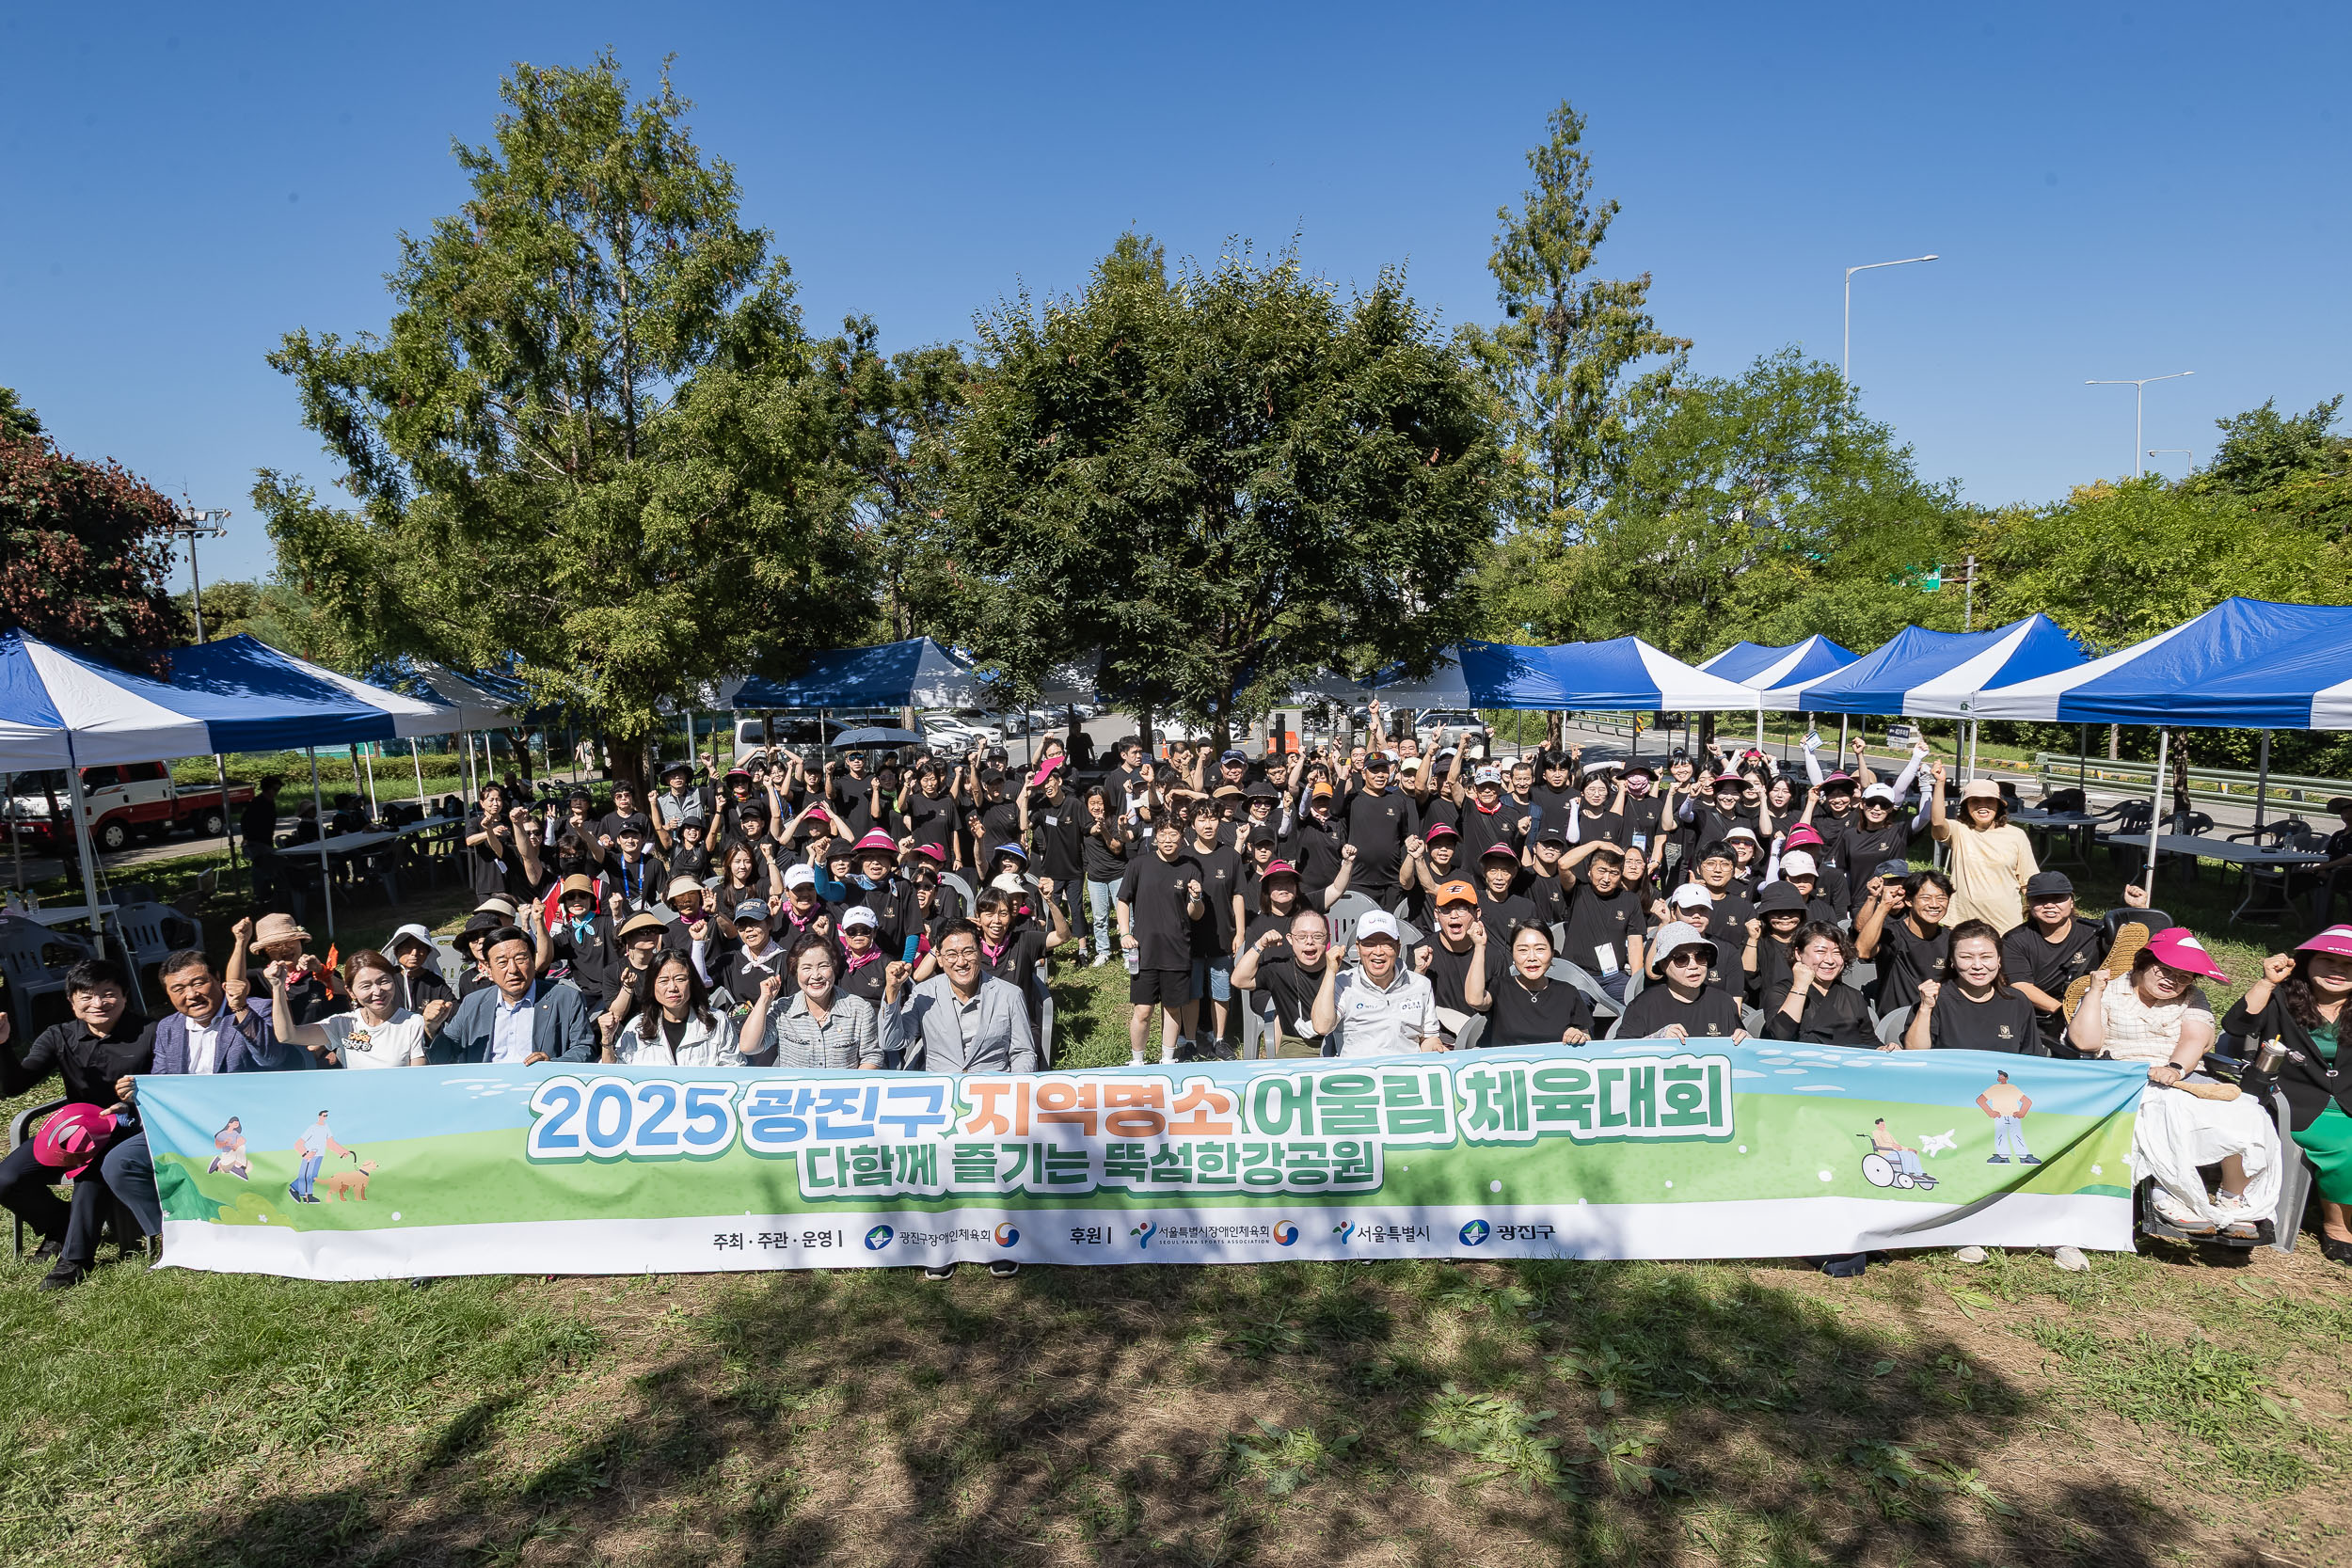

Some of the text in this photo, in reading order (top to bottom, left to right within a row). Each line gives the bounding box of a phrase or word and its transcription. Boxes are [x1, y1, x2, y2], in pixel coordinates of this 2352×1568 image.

[537, 1064, 1724, 1148] 2025 광진구 지역명소 어울림 체육대회
[805, 1140, 1375, 1189] 다함께 즐기는 뚝섬한강공원
[713, 1229, 833, 1251] 주최 주관 운영
[899, 1229, 991, 1247] 광진구장애인체육회
[1069, 1226, 1103, 1245] 후원
[1158, 1225, 1270, 1239] 서울특별시장애인체육회
[1358, 1225, 1431, 1243] 서울특별시
[1496, 1225, 1557, 1241] 광진구
